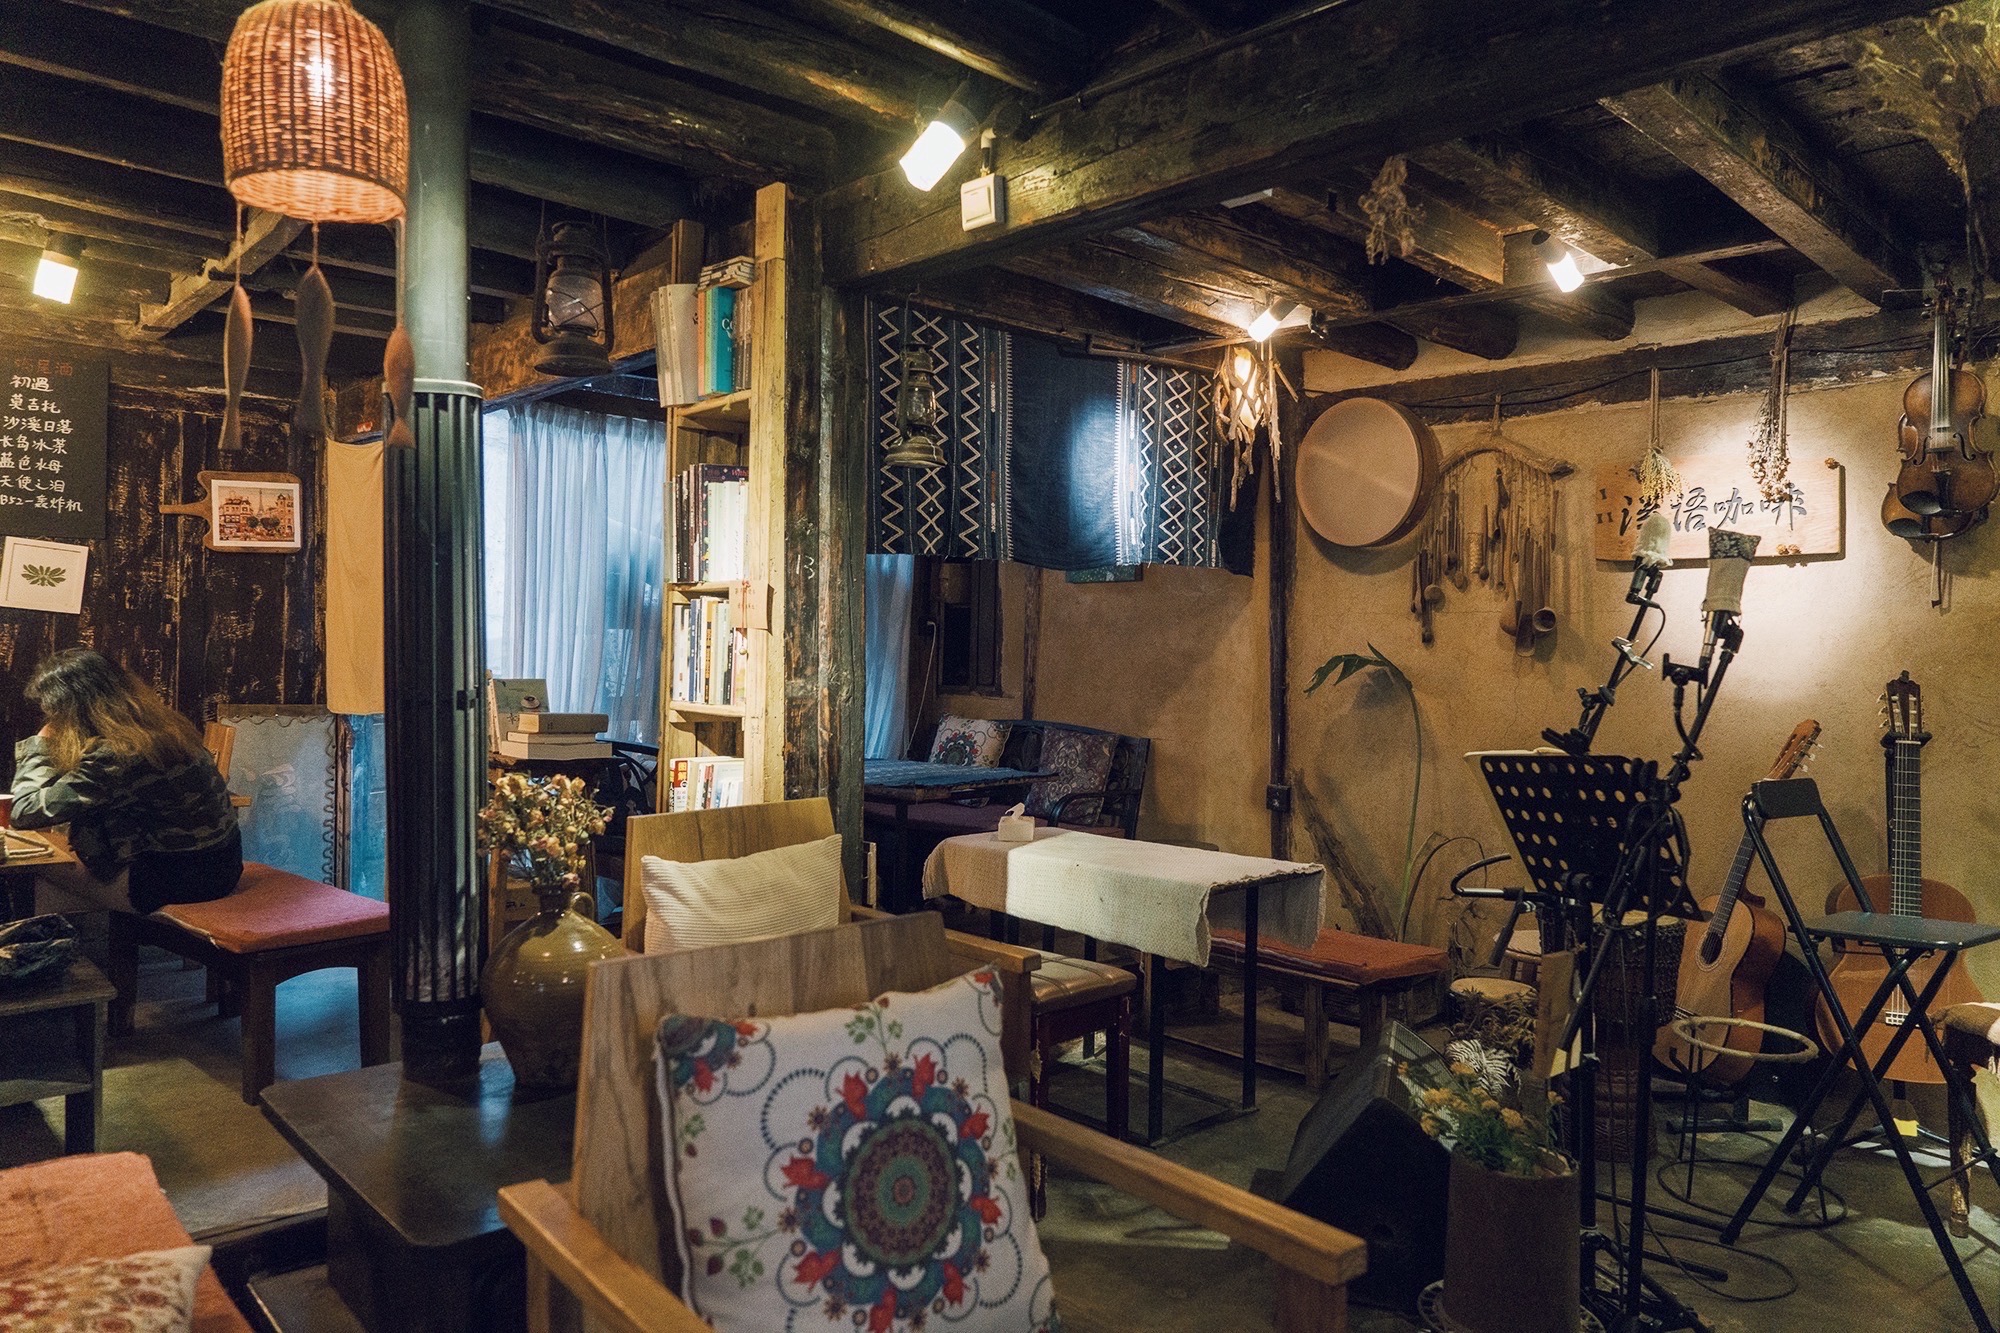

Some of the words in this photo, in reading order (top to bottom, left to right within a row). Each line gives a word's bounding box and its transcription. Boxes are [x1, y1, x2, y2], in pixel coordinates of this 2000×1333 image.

[9, 393, 61, 413] 莫吉托
[3, 415, 73, 434] 沙溪日落
[0, 434, 67, 454] 长岛冰茶
[0, 452, 63, 473] 蓝色水母
[0, 474, 65, 492] 天使之泪
